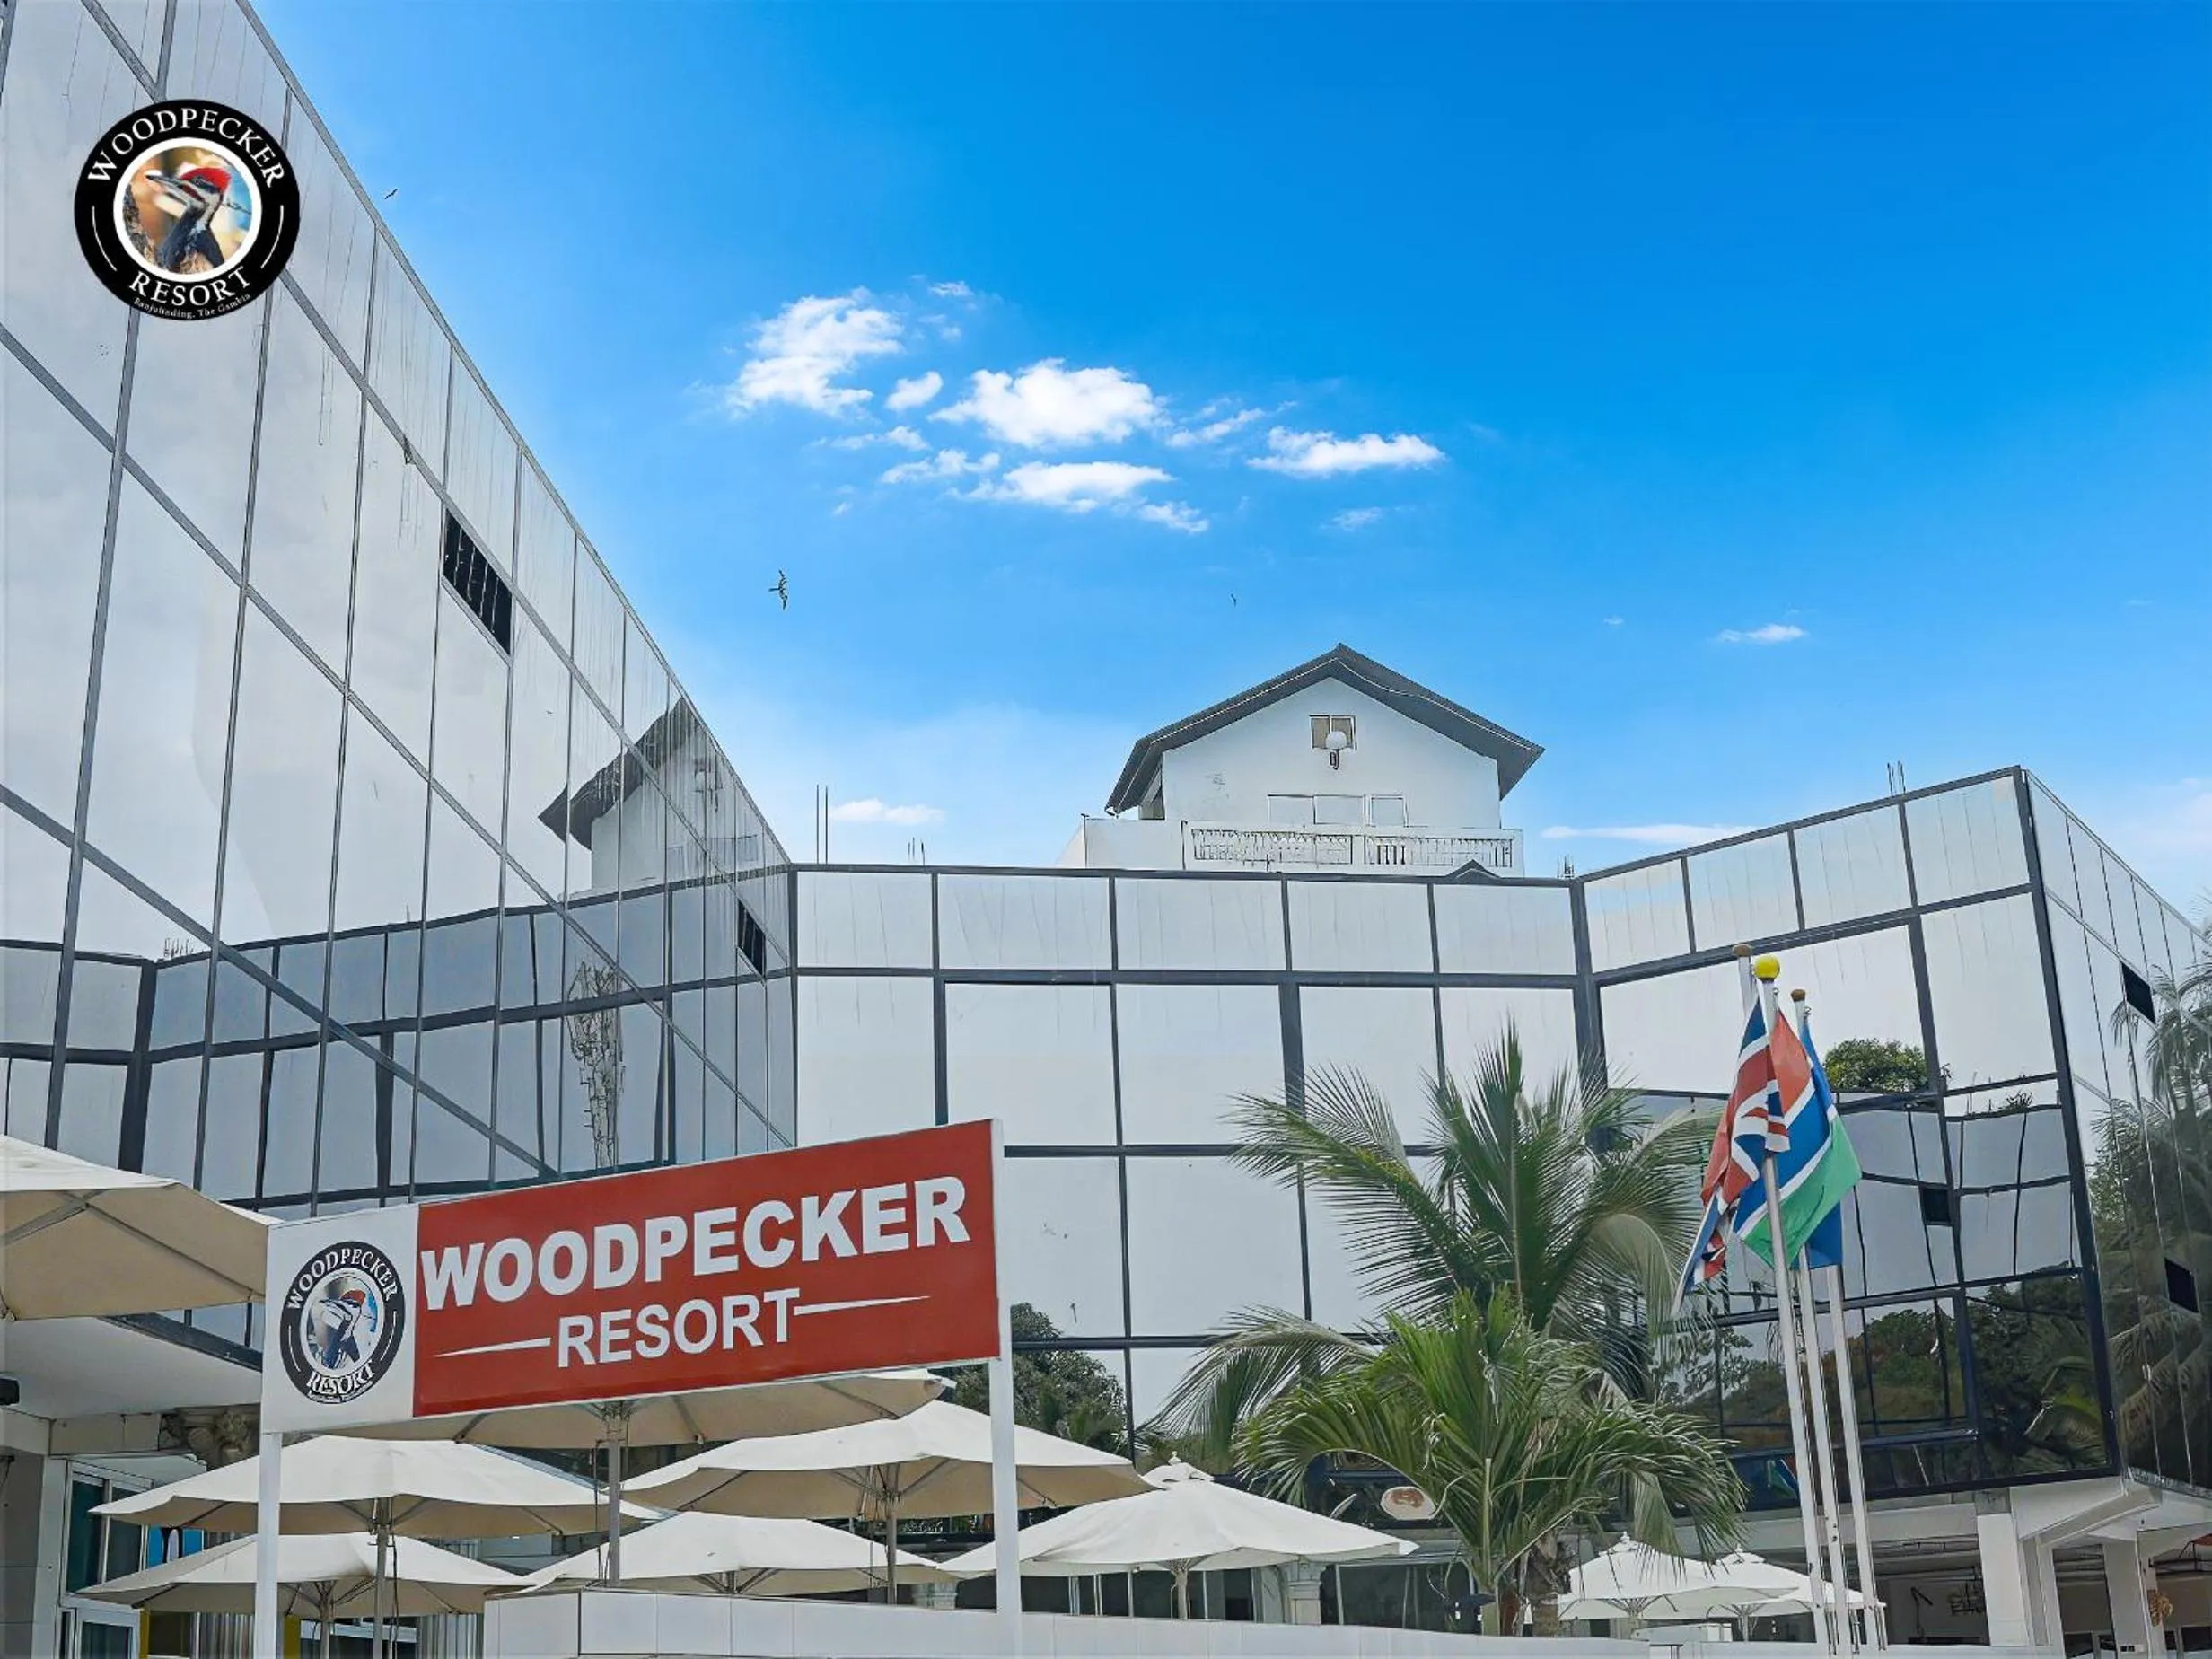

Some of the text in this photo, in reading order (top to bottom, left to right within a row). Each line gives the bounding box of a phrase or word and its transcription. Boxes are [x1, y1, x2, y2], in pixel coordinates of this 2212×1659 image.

[286, 1248, 398, 1310] WOODPECKER
[420, 1176, 971, 1311] WOODPECKER
[558, 1287, 801, 1368] RESORT
[306, 1359, 375, 1394] RESORT
